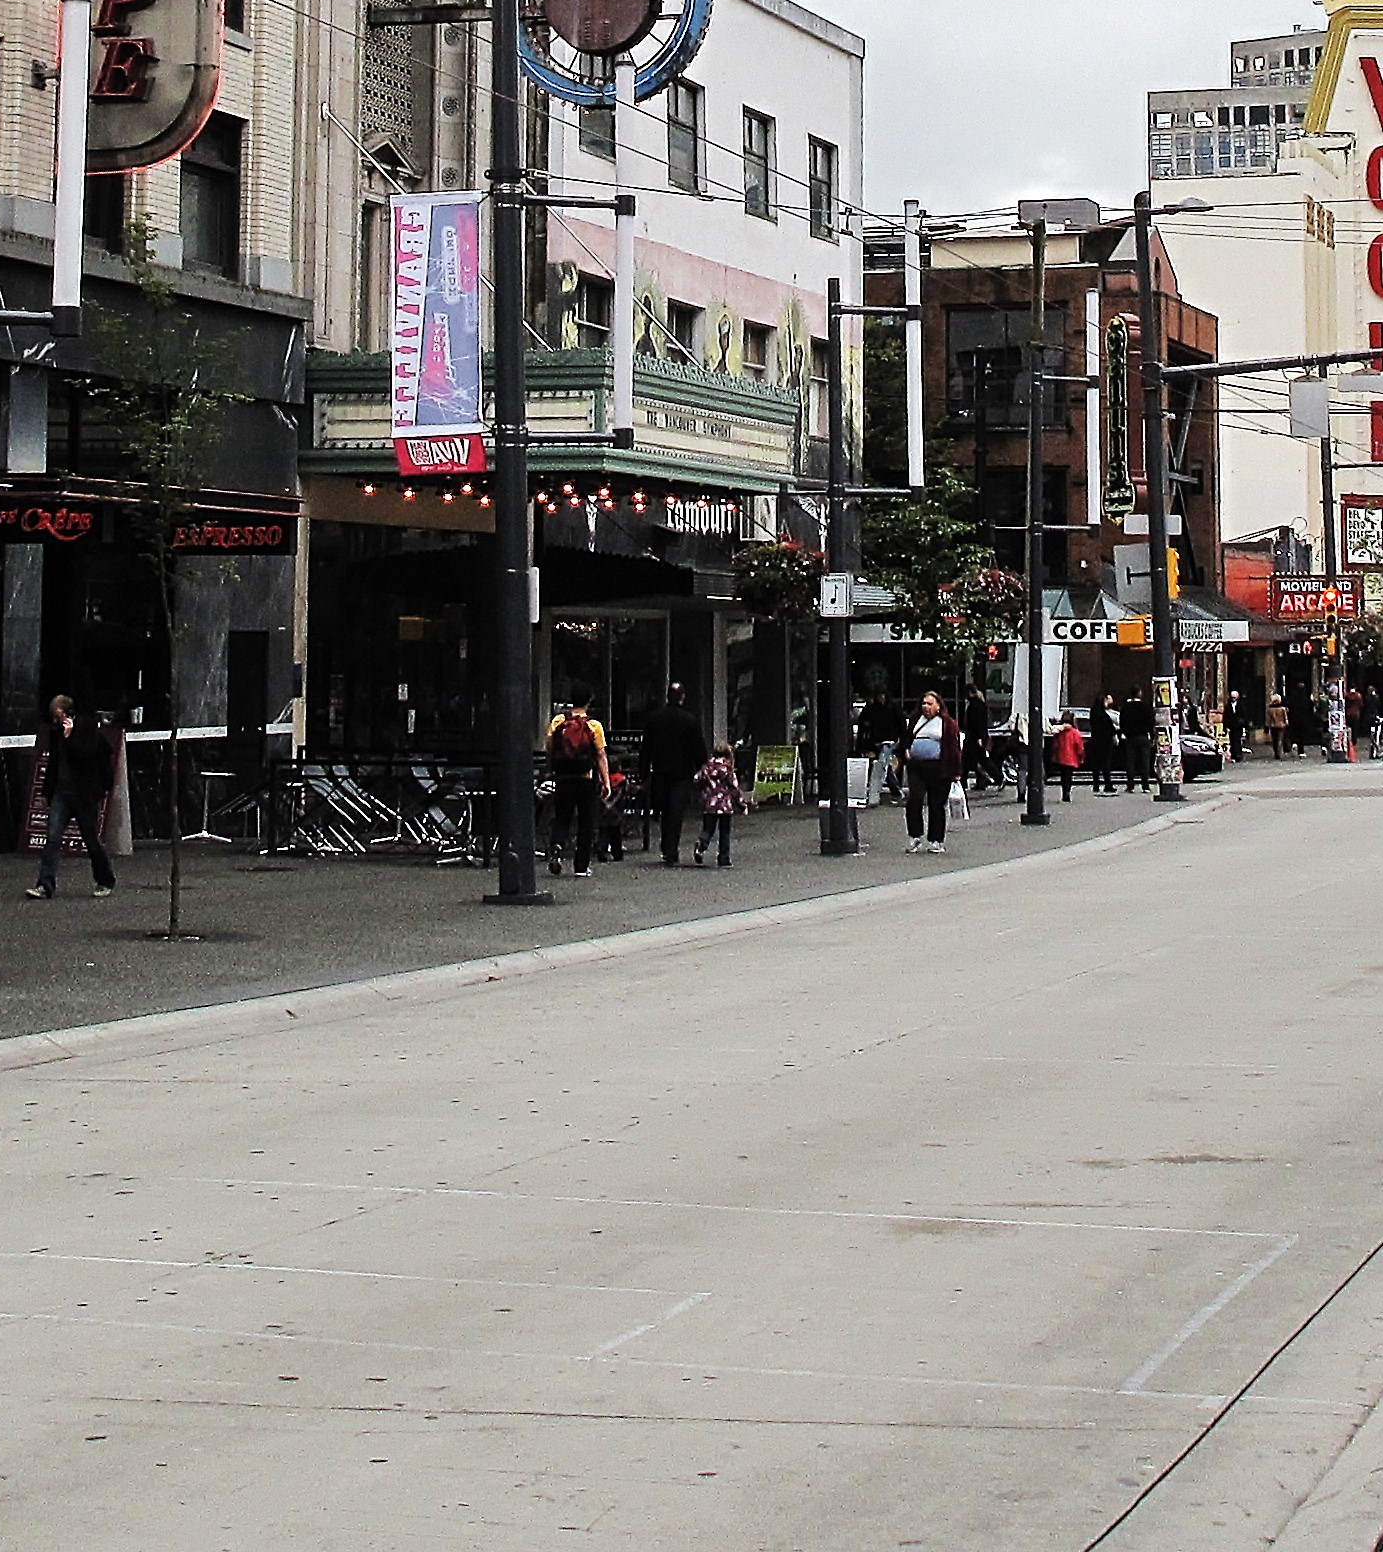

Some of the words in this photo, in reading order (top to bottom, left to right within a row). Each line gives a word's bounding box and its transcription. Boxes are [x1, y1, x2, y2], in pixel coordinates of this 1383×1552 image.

[170, 523, 284, 548] ESPRESSO
[1280, 580, 1353, 593] MOVIELND
[1180, 641, 1224, 653] PIZZA
